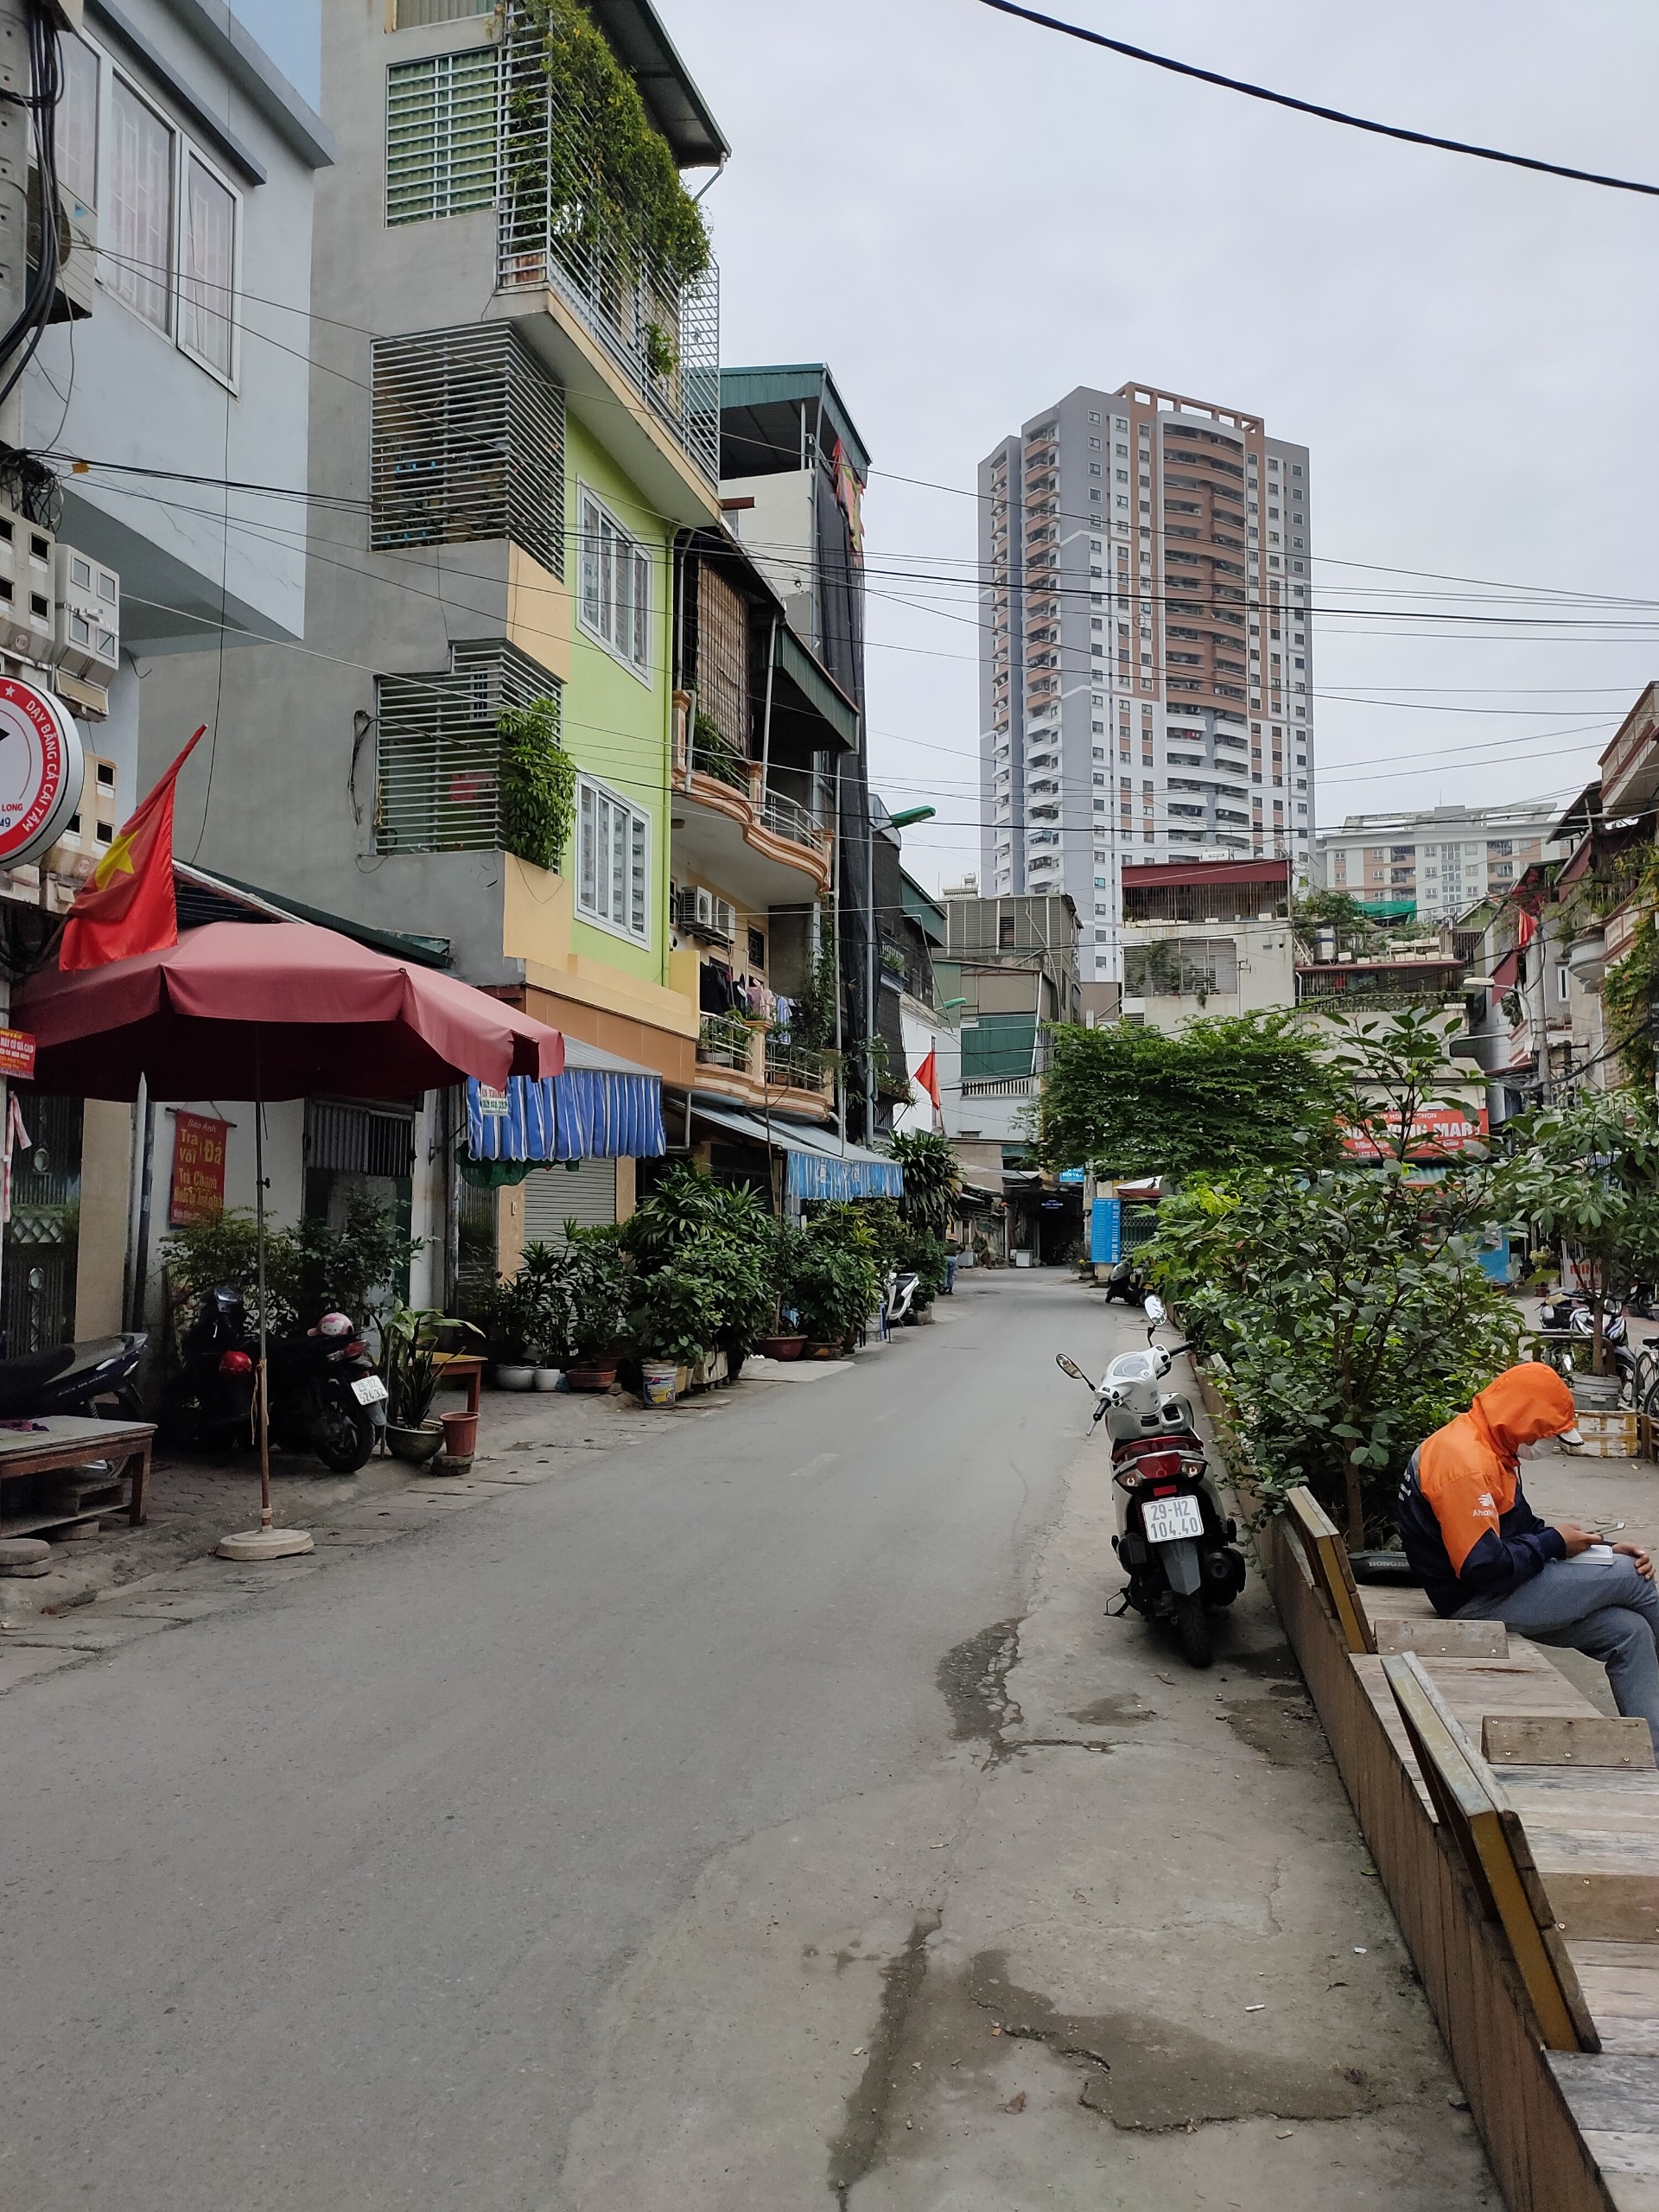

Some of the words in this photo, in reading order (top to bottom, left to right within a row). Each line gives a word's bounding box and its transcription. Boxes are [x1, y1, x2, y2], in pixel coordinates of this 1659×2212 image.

[1, 803, 23, 812] LONG
[1150, 1500, 1191, 1521] 29-H2
[1150, 1516, 1198, 1539] 104.40
